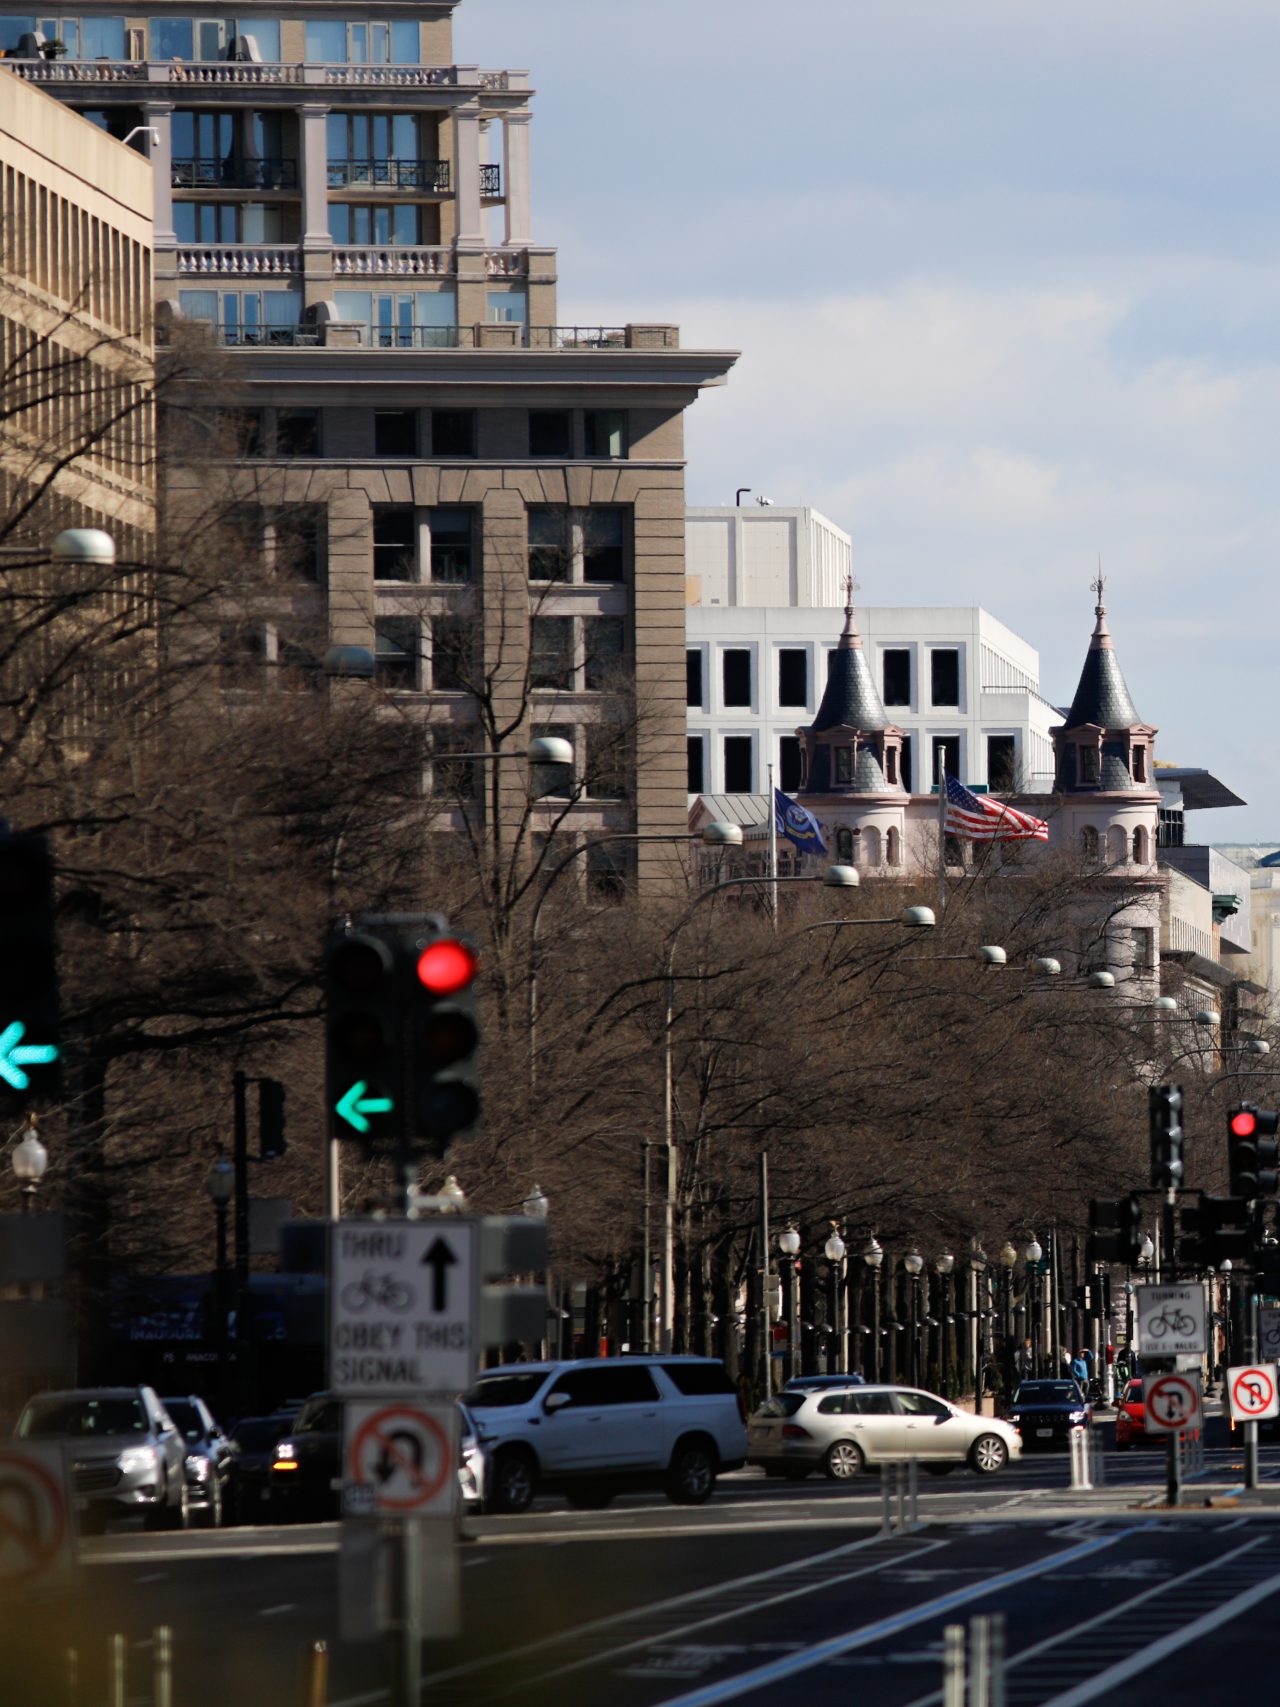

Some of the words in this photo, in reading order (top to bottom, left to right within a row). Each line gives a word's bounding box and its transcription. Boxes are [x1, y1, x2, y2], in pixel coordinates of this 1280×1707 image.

[342, 1231, 405, 1259] THRU
[335, 1322, 401, 1351] OBEY
[415, 1322, 465, 1350] THIS
[335, 1356, 423, 1384] SIGNAL
